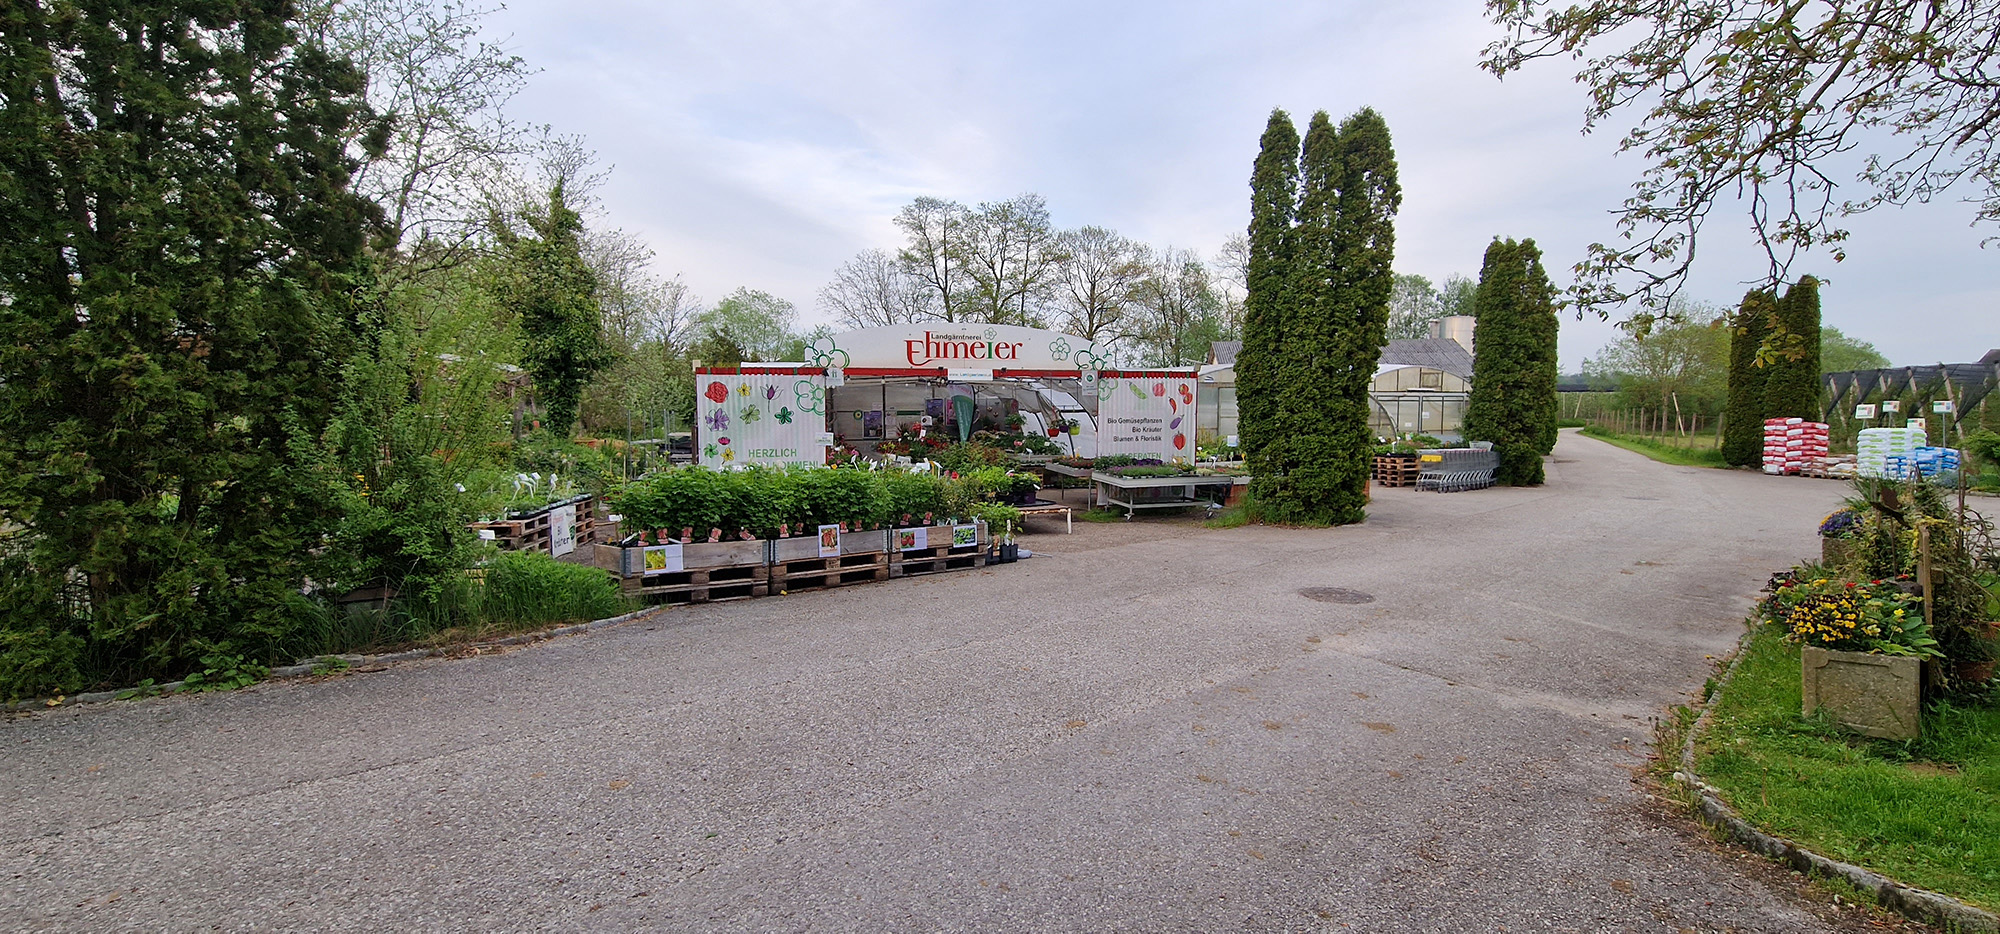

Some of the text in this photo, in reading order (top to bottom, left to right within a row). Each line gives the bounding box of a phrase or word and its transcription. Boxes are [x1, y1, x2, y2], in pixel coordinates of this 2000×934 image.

[904, 331, 1023, 366] Ehmeier
[1118, 417, 1162, 425] Gemüsepflanzen
[748, 448, 797, 458] HERZLICH
